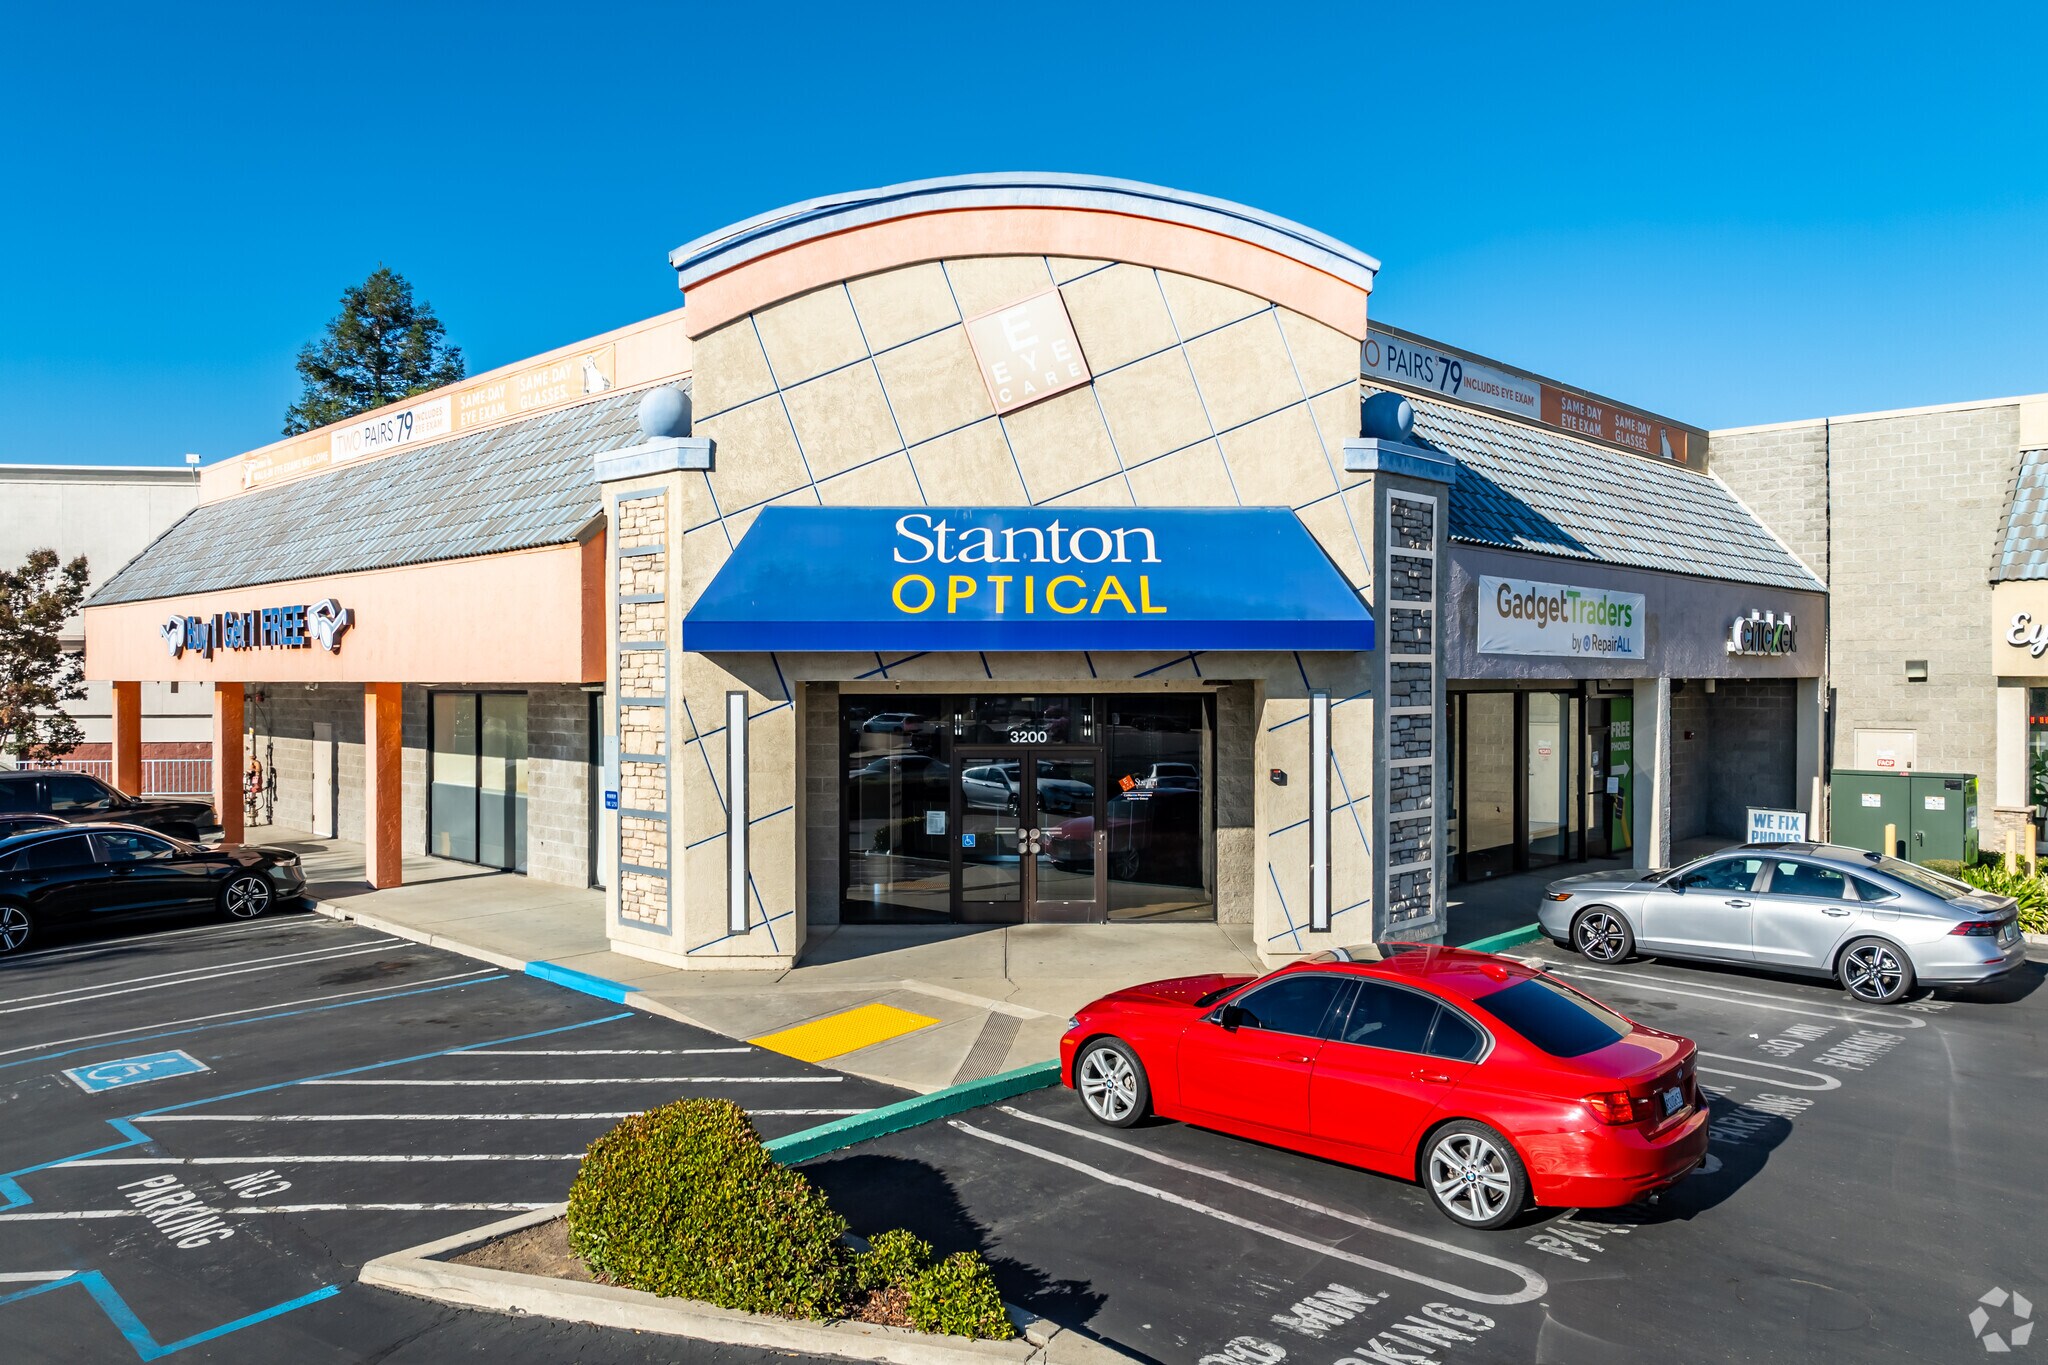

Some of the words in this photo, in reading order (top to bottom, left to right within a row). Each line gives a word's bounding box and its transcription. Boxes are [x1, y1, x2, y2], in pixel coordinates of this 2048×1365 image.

[1000, 306, 1040, 352] E
[991, 339, 1072, 385] EYE
[519, 363, 573, 392] SAME-DAY
[999, 362, 1081, 403] CARE
[1387, 345, 1434, 383] PAIRS
[1463, 376, 1500, 397] INCLUDES
[1501, 387, 1514, 401] EYE
[1515, 391, 1535, 407] EXAM
[460, 384, 507, 409] SAME-DAY
[520, 384, 569, 410] GLASSES.
[1561, 397, 1603, 421] SAME-DAY
[414, 406, 444, 423] INCLUDES
[415, 424, 425, 434] EYE
[426, 418, 443, 432] EXAM
[461, 408, 477, 426] EYE
[479, 402, 507, 421] EXAM.
[1561, 413, 1577, 429] EYE
[1579, 418, 1604, 437] EXAM.
[1614, 414, 1652, 437] SAME-DAY
[336, 430, 361, 456] TWO
[364, 420, 394, 447] PAIRS
[1615, 429, 1649, 450] GLASSES.
[893, 513, 1162, 564] Stanton
[892, 574, 1168, 614] OPTICAL
[1496, 583, 1632, 629] GadgetTraders
[187, 616, 210, 659] Buy
[224, 611, 246, 648] Get
[262, 605, 304, 646] FREE
[1572, 633, 1583, 653] by
[1592, 634, 1632, 655] RepairALL
[1740, 612, 1798, 653] cricket
[1010, 731, 1047, 743] 3200
[1611, 721, 1630, 738] FREE
[1611, 741, 1631, 751] PHONES
[1754, 813, 1774, 829] WE
[1778, 815, 1800, 831] FIX
[1751, 830, 1802, 843] PHONES
[1812, 1029, 1906, 1071] PARKING
[1709, 1093, 1815, 1144] PARKING
[223, 1169, 292, 1198] NO
[117, 1173, 235, 1249] PARKING
